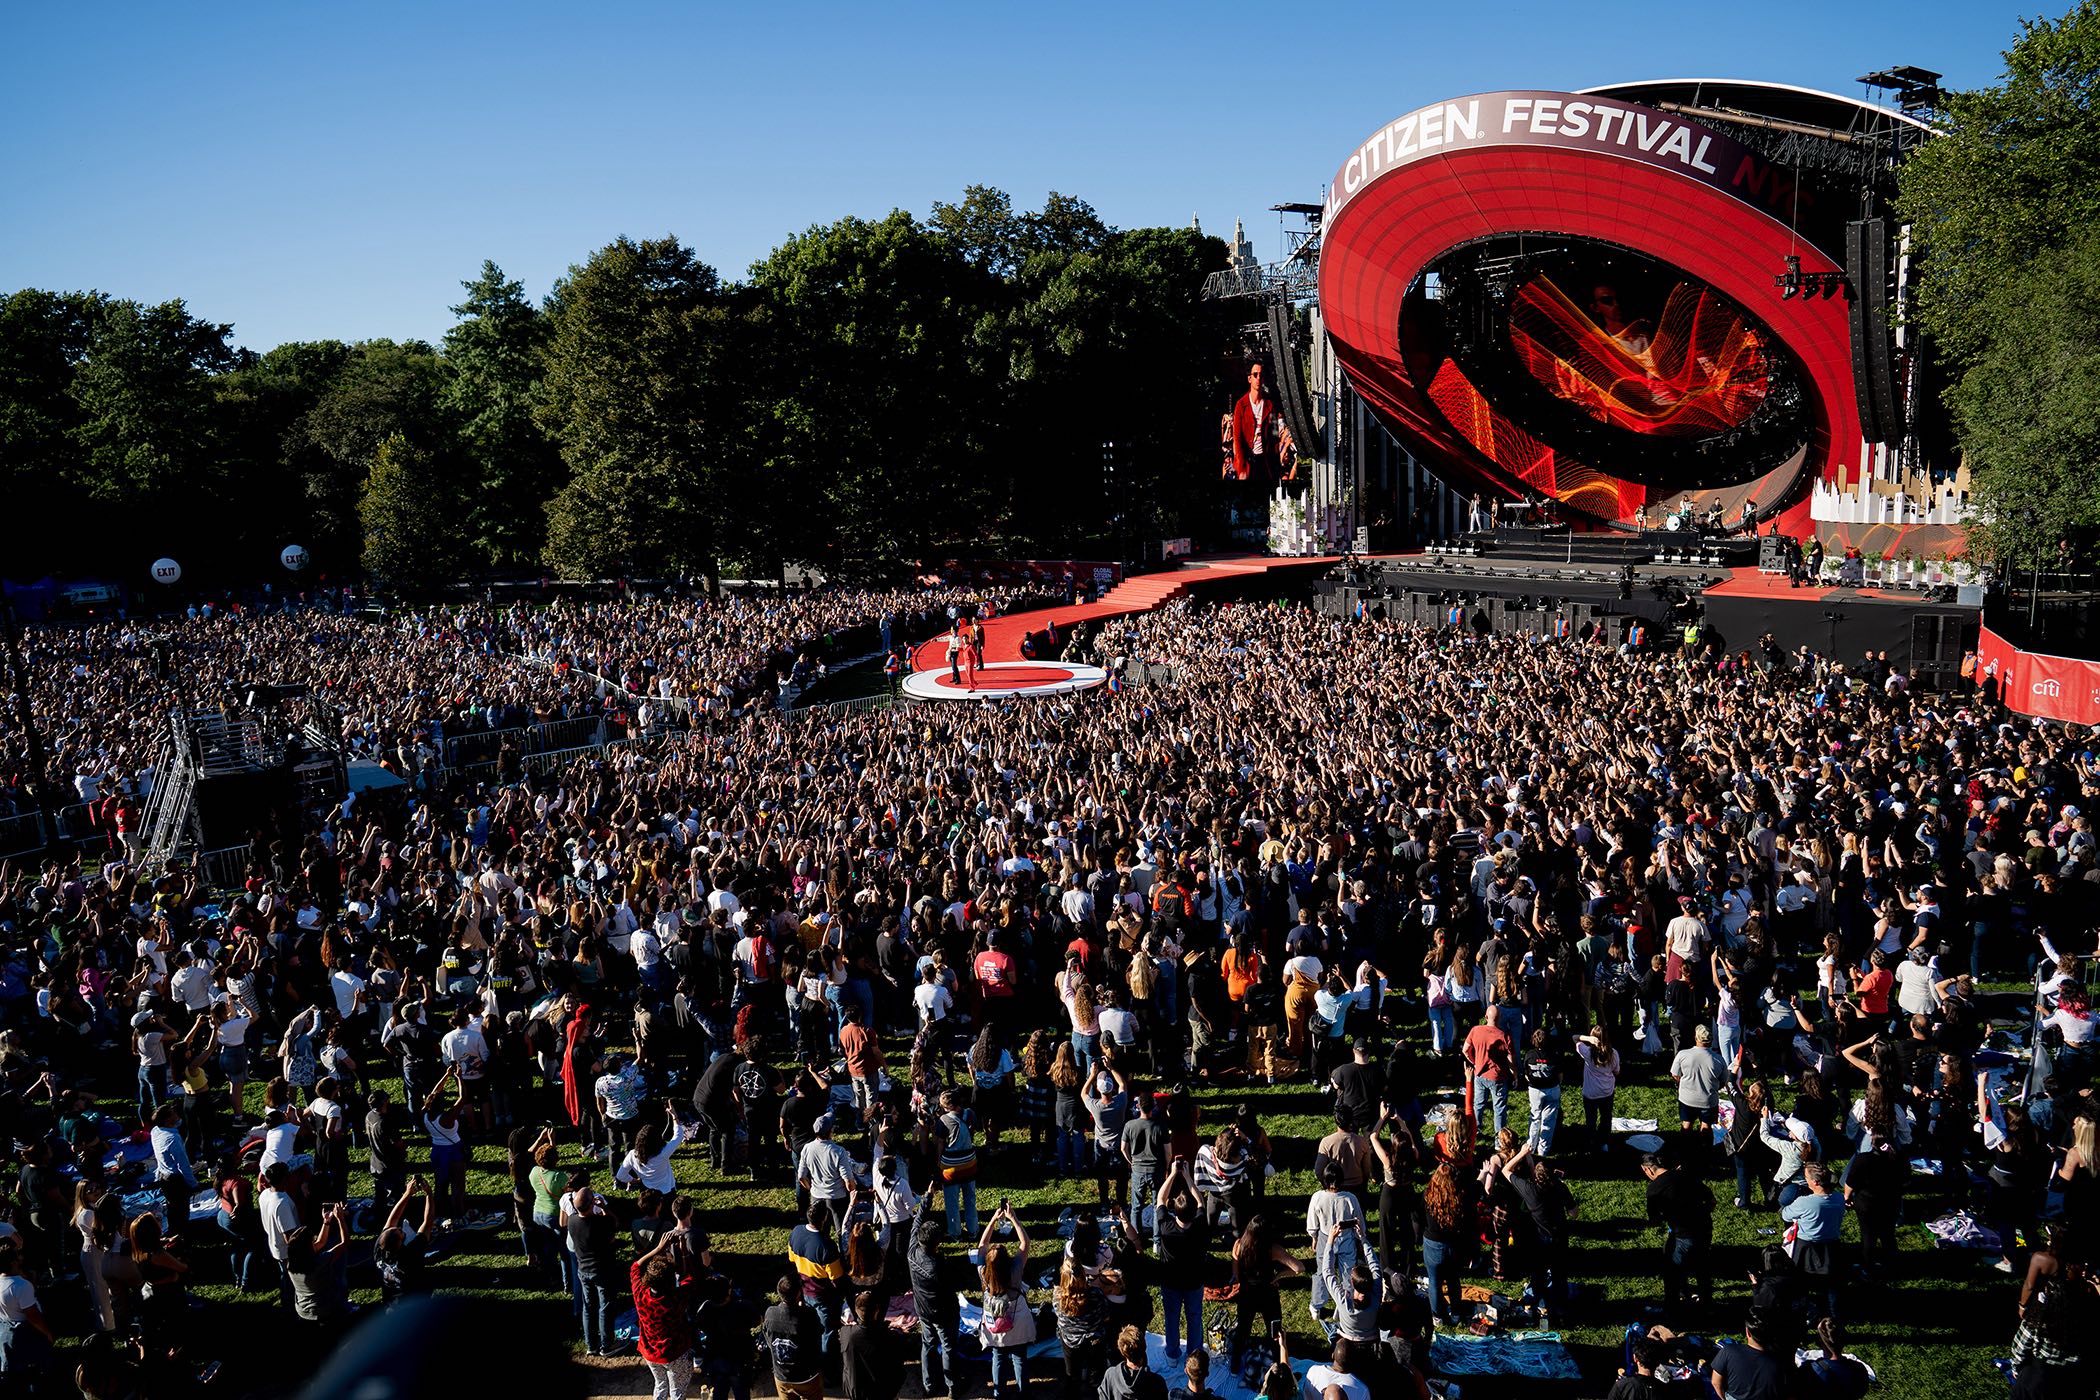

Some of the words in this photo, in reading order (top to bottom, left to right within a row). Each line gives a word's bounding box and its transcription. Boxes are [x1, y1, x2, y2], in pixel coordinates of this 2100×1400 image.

[1502, 99, 1717, 175] FESTIVAL
[1731, 153, 1816, 223] NYC
[157, 567, 176, 577] EXIT
